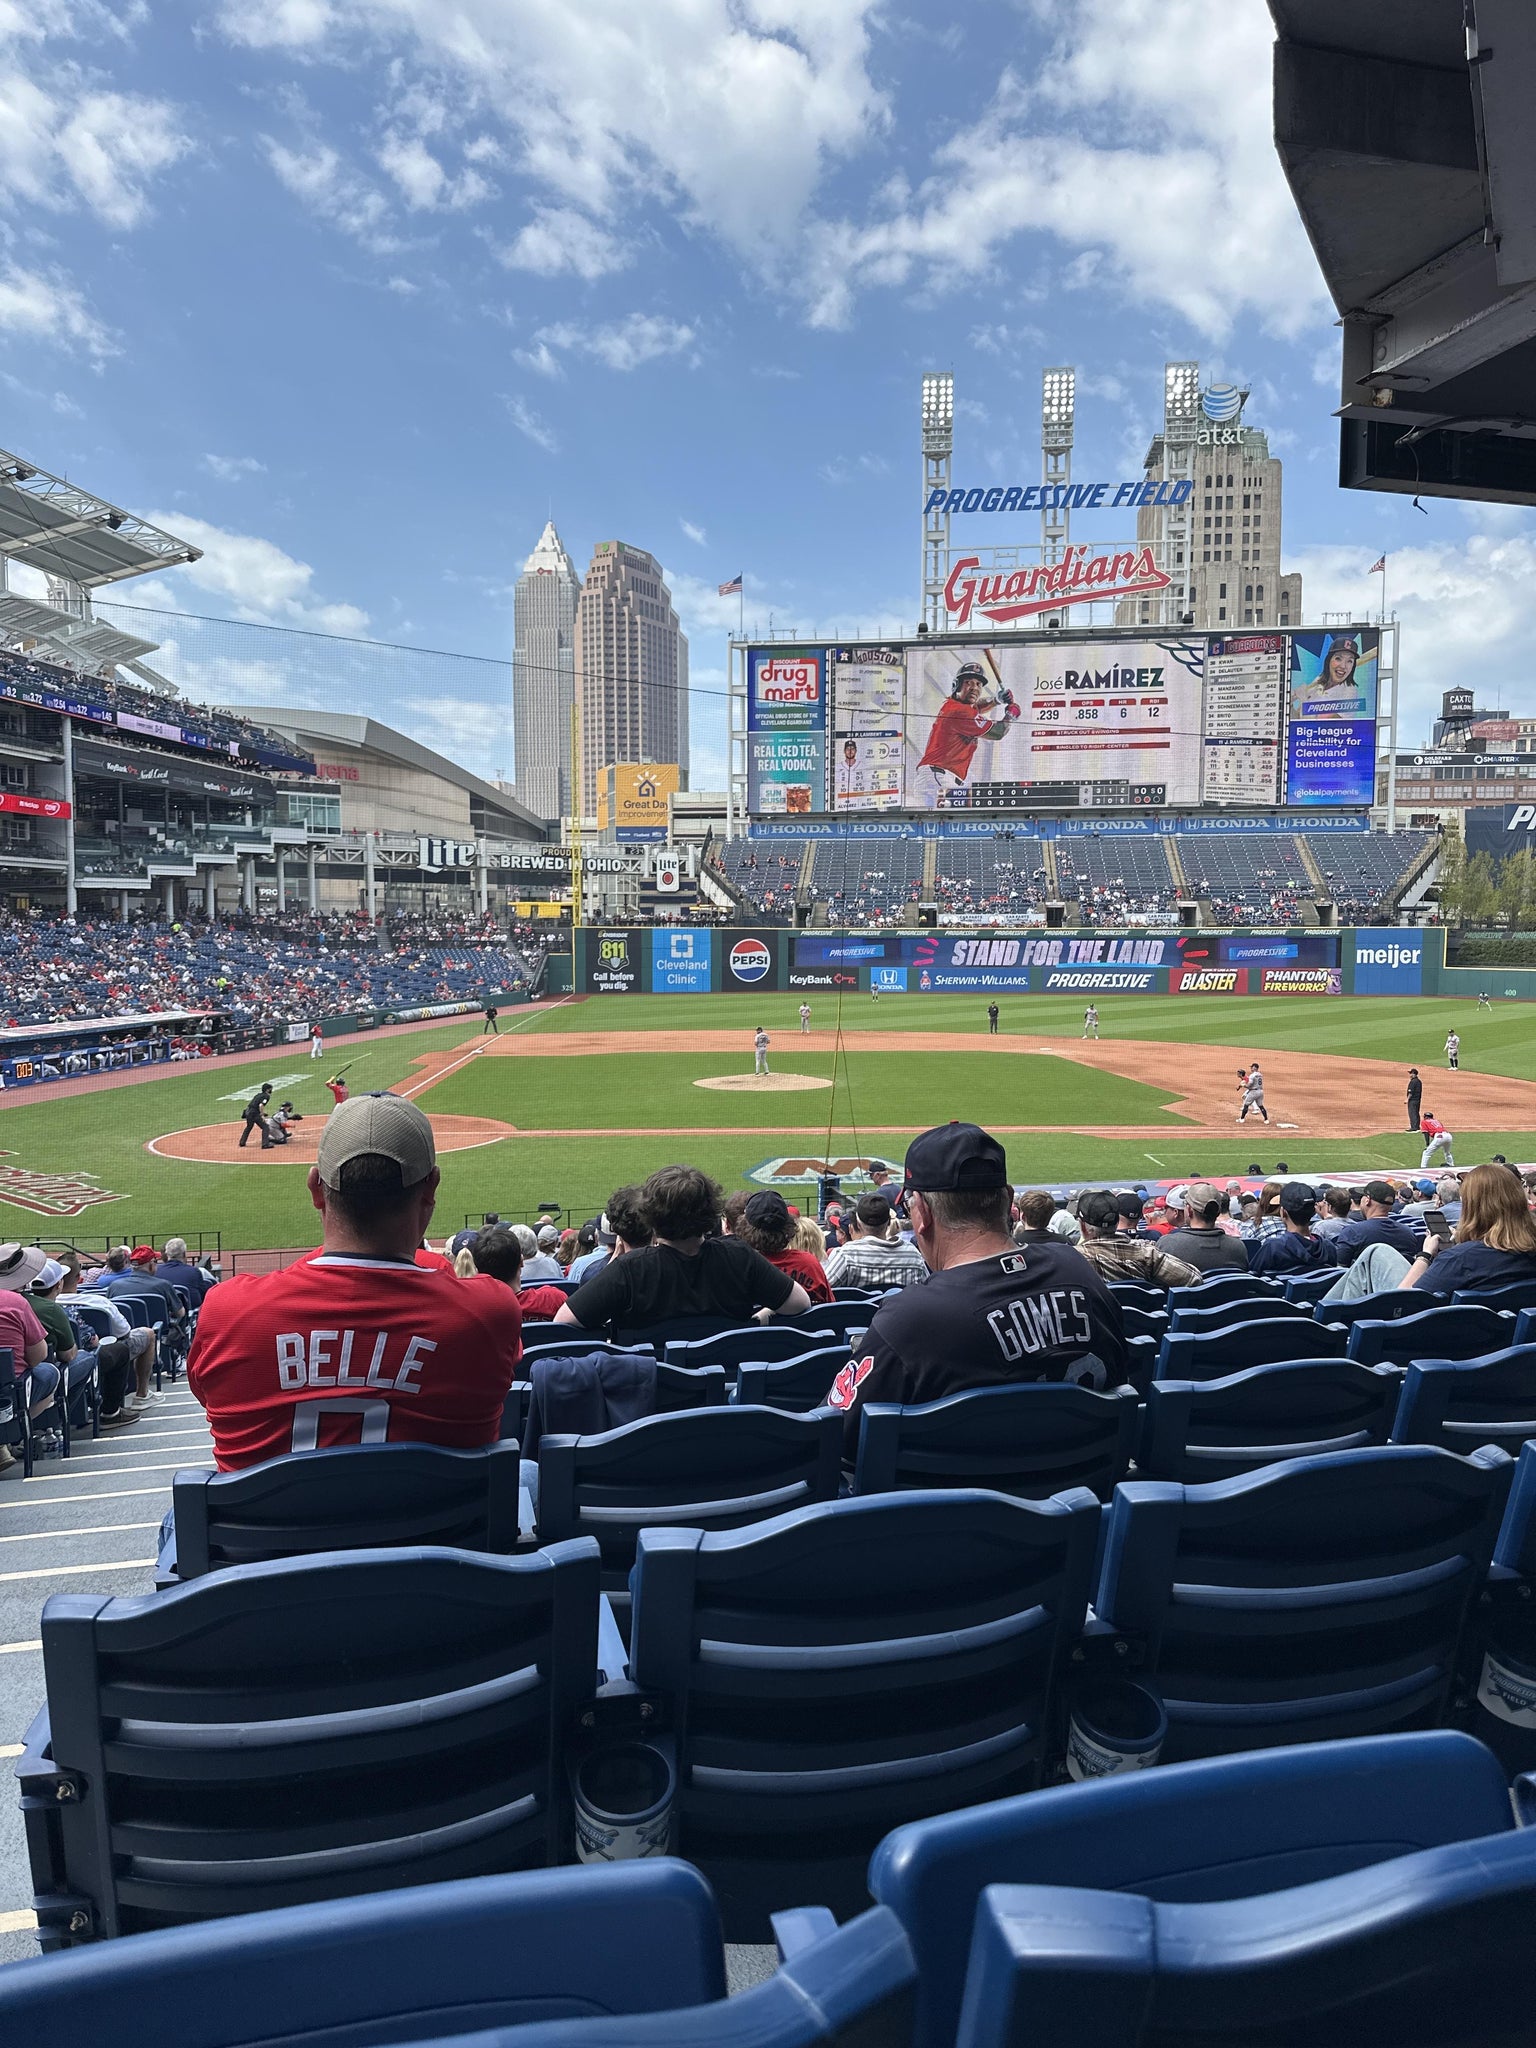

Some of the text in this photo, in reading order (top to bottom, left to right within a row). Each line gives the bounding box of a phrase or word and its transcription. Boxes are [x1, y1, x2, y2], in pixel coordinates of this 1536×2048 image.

[1197, 427, 1244, 446] at&t
[923, 481, 1193, 514] PROGRESSIVE FIELD
[943, 546, 1171, 628] Guardians
[1228, 638, 1277, 653] GUARDIANS
[761, 661, 808, 686] drug
[1034, 663, 1164, 691] José RAMÍREZ
[765, 685, 818, 700] mart
[1308, 701, 1361, 712] PROGRESSIVE
[1036, 707, 1160, 720] .239 .858 6 12
[1296, 727, 1353, 738] Big-league
[1346, 737, 1362, 746] for
[754, 744, 820, 758] REAL ICED TEA.
[1295, 748, 1347, 757] Cleveland
[107, 762, 128, 773] KeyBank
[758, 759, 816, 772] REAL VODKA.
[1295, 760, 1355, 768] businesses
[1140, 787, 1147, 795] 0
[623, 800, 650, 809] Great
[964, 822, 1029, 832] HONDA
[1081, 820, 1148, 830] HONDA
[1200, 818, 1270, 829] HONDA
[1290, 817, 1361, 828] HONDA
[771, 825, 833, 834] HONDA
[852, 824, 916, 833] HONDA
[416, 837, 476, 874] Lite
[500, 855, 564, 870] BREWED
[586, 859, 622, 872] OHIO
[659, 859, 677, 872] Lite
[601, 941, 626, 959] 811
[829, 947, 876, 957] PROGRESSIVE
[951, 940, 1165, 966] STAND FOR THE LAND
[1236, 947, 1289, 957] PROGRESSIVE
[732, 955, 768, 965] PEPSI
[1356, 944, 1420, 969] meijer
[656, 960, 708, 970] Cleveland
[593, 972, 634, 981] Call before
[667, 974, 697, 984] Clinic
[790, 974, 833, 986] KeyBank
[1046, 973, 1150, 989] PROGRESSIVE
[1179, 971, 1237, 991] BLASTER
[1265, 970, 1328, 982] PHANTOM
[600, 982, 629, 991] you dig.
[1263, 982, 1326, 992] FIREWORKS
[1504, 989, 1517, 997] 400
[987, 1291, 1092, 1362] GOMES
[276, 1330, 438, 1394] BELLE
[1502, 1691, 1527, 1706] FIELD
